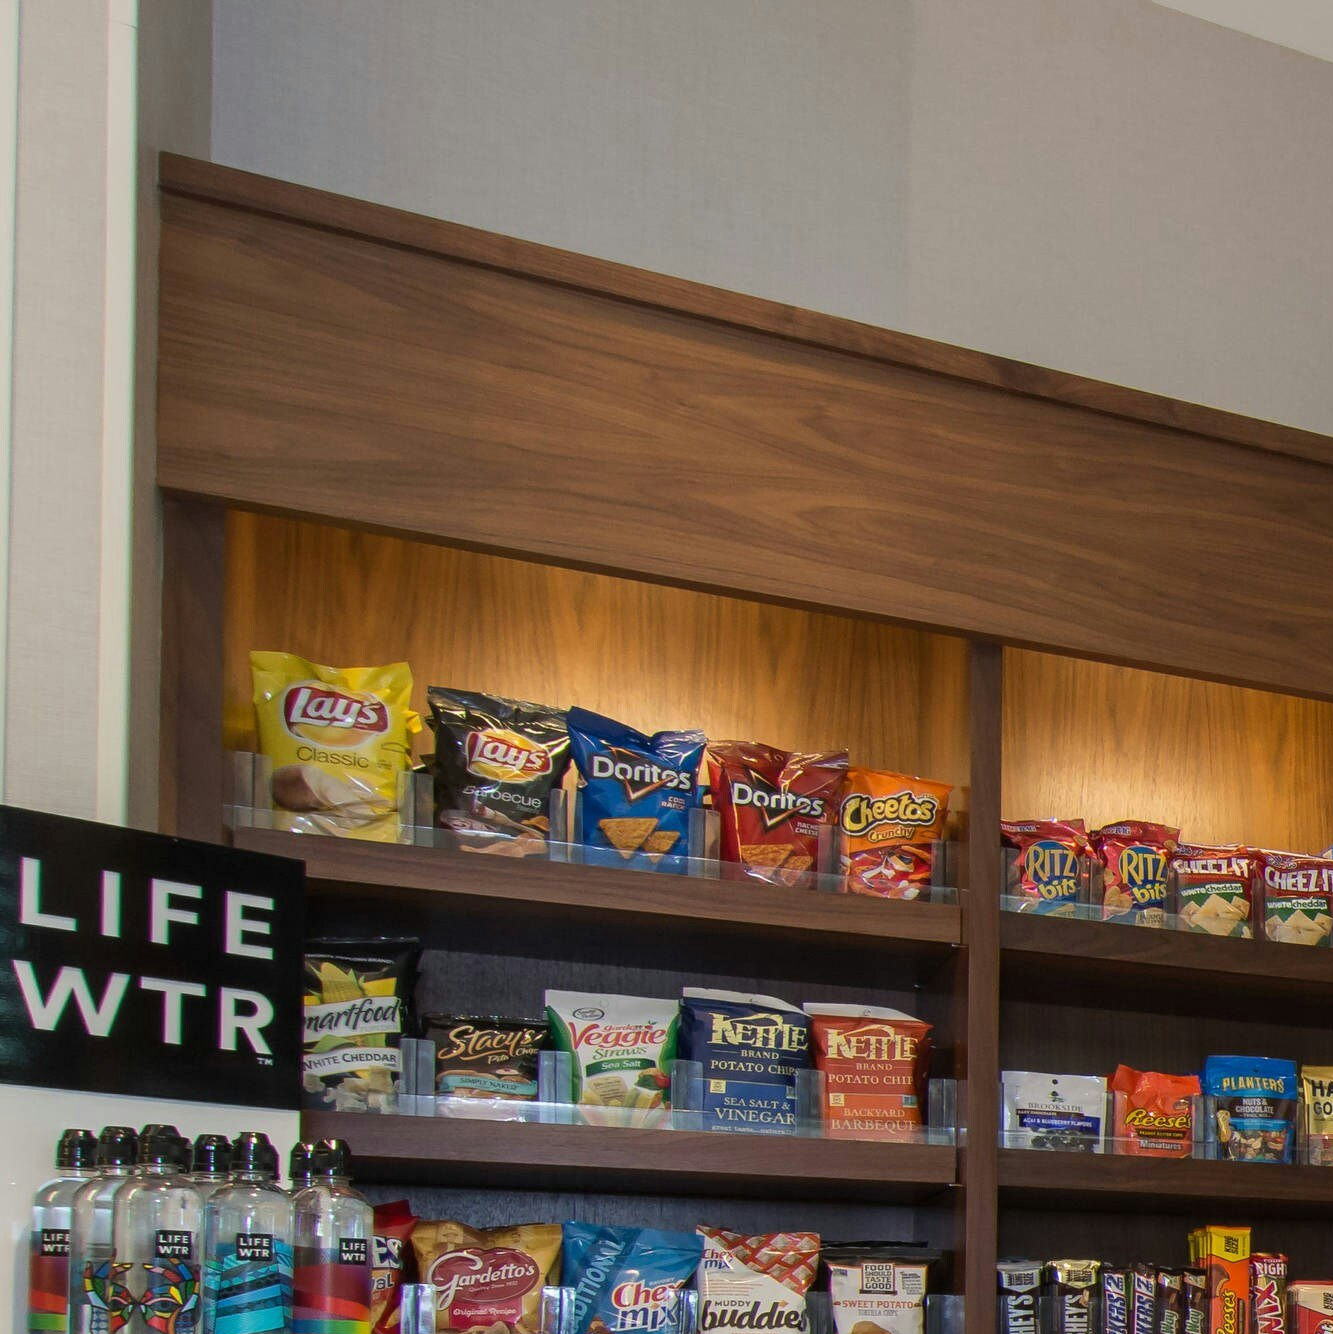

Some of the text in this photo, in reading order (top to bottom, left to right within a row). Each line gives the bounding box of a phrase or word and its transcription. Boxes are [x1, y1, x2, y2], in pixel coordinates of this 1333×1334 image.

[290, 688, 380, 728] Lay's
[296, 745, 369, 769] Classic
[471, 733, 546, 772] Lay's
[592, 756, 692, 790] Doritos
[461, 785, 543, 809] Barbecue
[732, 781, 825, 817] Doritos
[842, 791, 937, 835] Cheetos
[867, 825, 916, 842] Crunchy
[1027, 845, 1074, 884] RITZ
[1120, 850, 1169, 885] RITZ
[1038, 879, 1077, 900] bits
[1130, 882, 1168, 904] bits
[19, 856, 275, 960] LIFE
[12, 958, 274, 1054] WTR
[303, 998, 400, 1032] martfood
[568, 1021, 668, 1050] Veggie
[707, 1012, 808, 1052] KETTLE
[438, 1025, 540, 1060] Stacy's
[823, 1024, 919, 1061] KETTLE
[341, 1052, 397, 1065] CHEDDAR
[593, 1046, 647, 1060] Straws
[741, 1049, 780, 1060] BRAND
[601, 1059, 642, 1070] Sea Salt
[711, 1060, 800, 1076] POTATO CHIPS
[856, 1063, 893, 1071] BRAND
[828, 1073, 914, 1085] POTATO CHIP
[1222, 1077, 1285, 1094] PLANTERS
[724, 1097, 746, 1106] SEA
[749, 1099, 779, 1109] SALT
[1028, 1102, 1083, 1112] BROOKSIDE
[1235, 1105, 1274, 1114] CHOCOLATE
[1242, 1098, 1259, 1106] NUTS
[715, 1107, 796, 1125] VINEGAR
[844, 1108, 905, 1118] BACKYARD
[1125, 1108, 1192, 1129] Reese's
[832, 1119, 917, 1134] BARBEQUE
[158, 1234, 189, 1243] LIFE
[239, 1236, 270, 1247] LIFE
[342, 1242, 366, 1251] LIFE
[1223, 1235, 1232, 1253] KING
[1230, 1237, 1239, 1254] SIZE
[159, 1245, 189, 1254] WTR
[239, 1247, 269, 1258] WTR
[342, 1251, 365, 1261] WTR
[842, 1300, 914, 1309] SWEET POTATO
[1322, 1292, 1331, 1309] KING
[453, 1307, 517, 1318] Original Recipe
